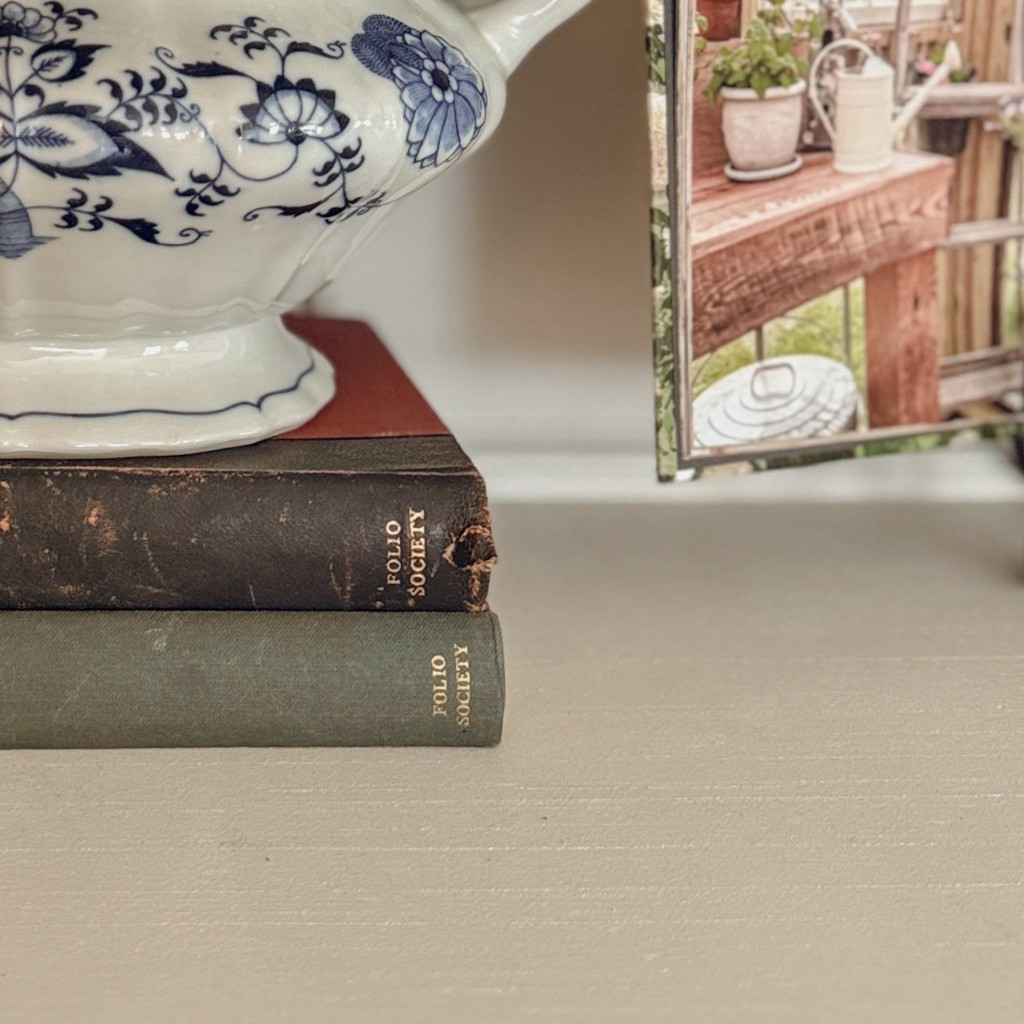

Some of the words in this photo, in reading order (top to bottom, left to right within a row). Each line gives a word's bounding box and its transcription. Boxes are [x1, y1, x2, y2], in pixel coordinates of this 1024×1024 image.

[386, 520, 402, 585] FOLIO
[407, 507, 427, 596] SOCIETY
[431, 655, 447, 716] FOLIO
[454, 643, 471, 726] SOCIETY
